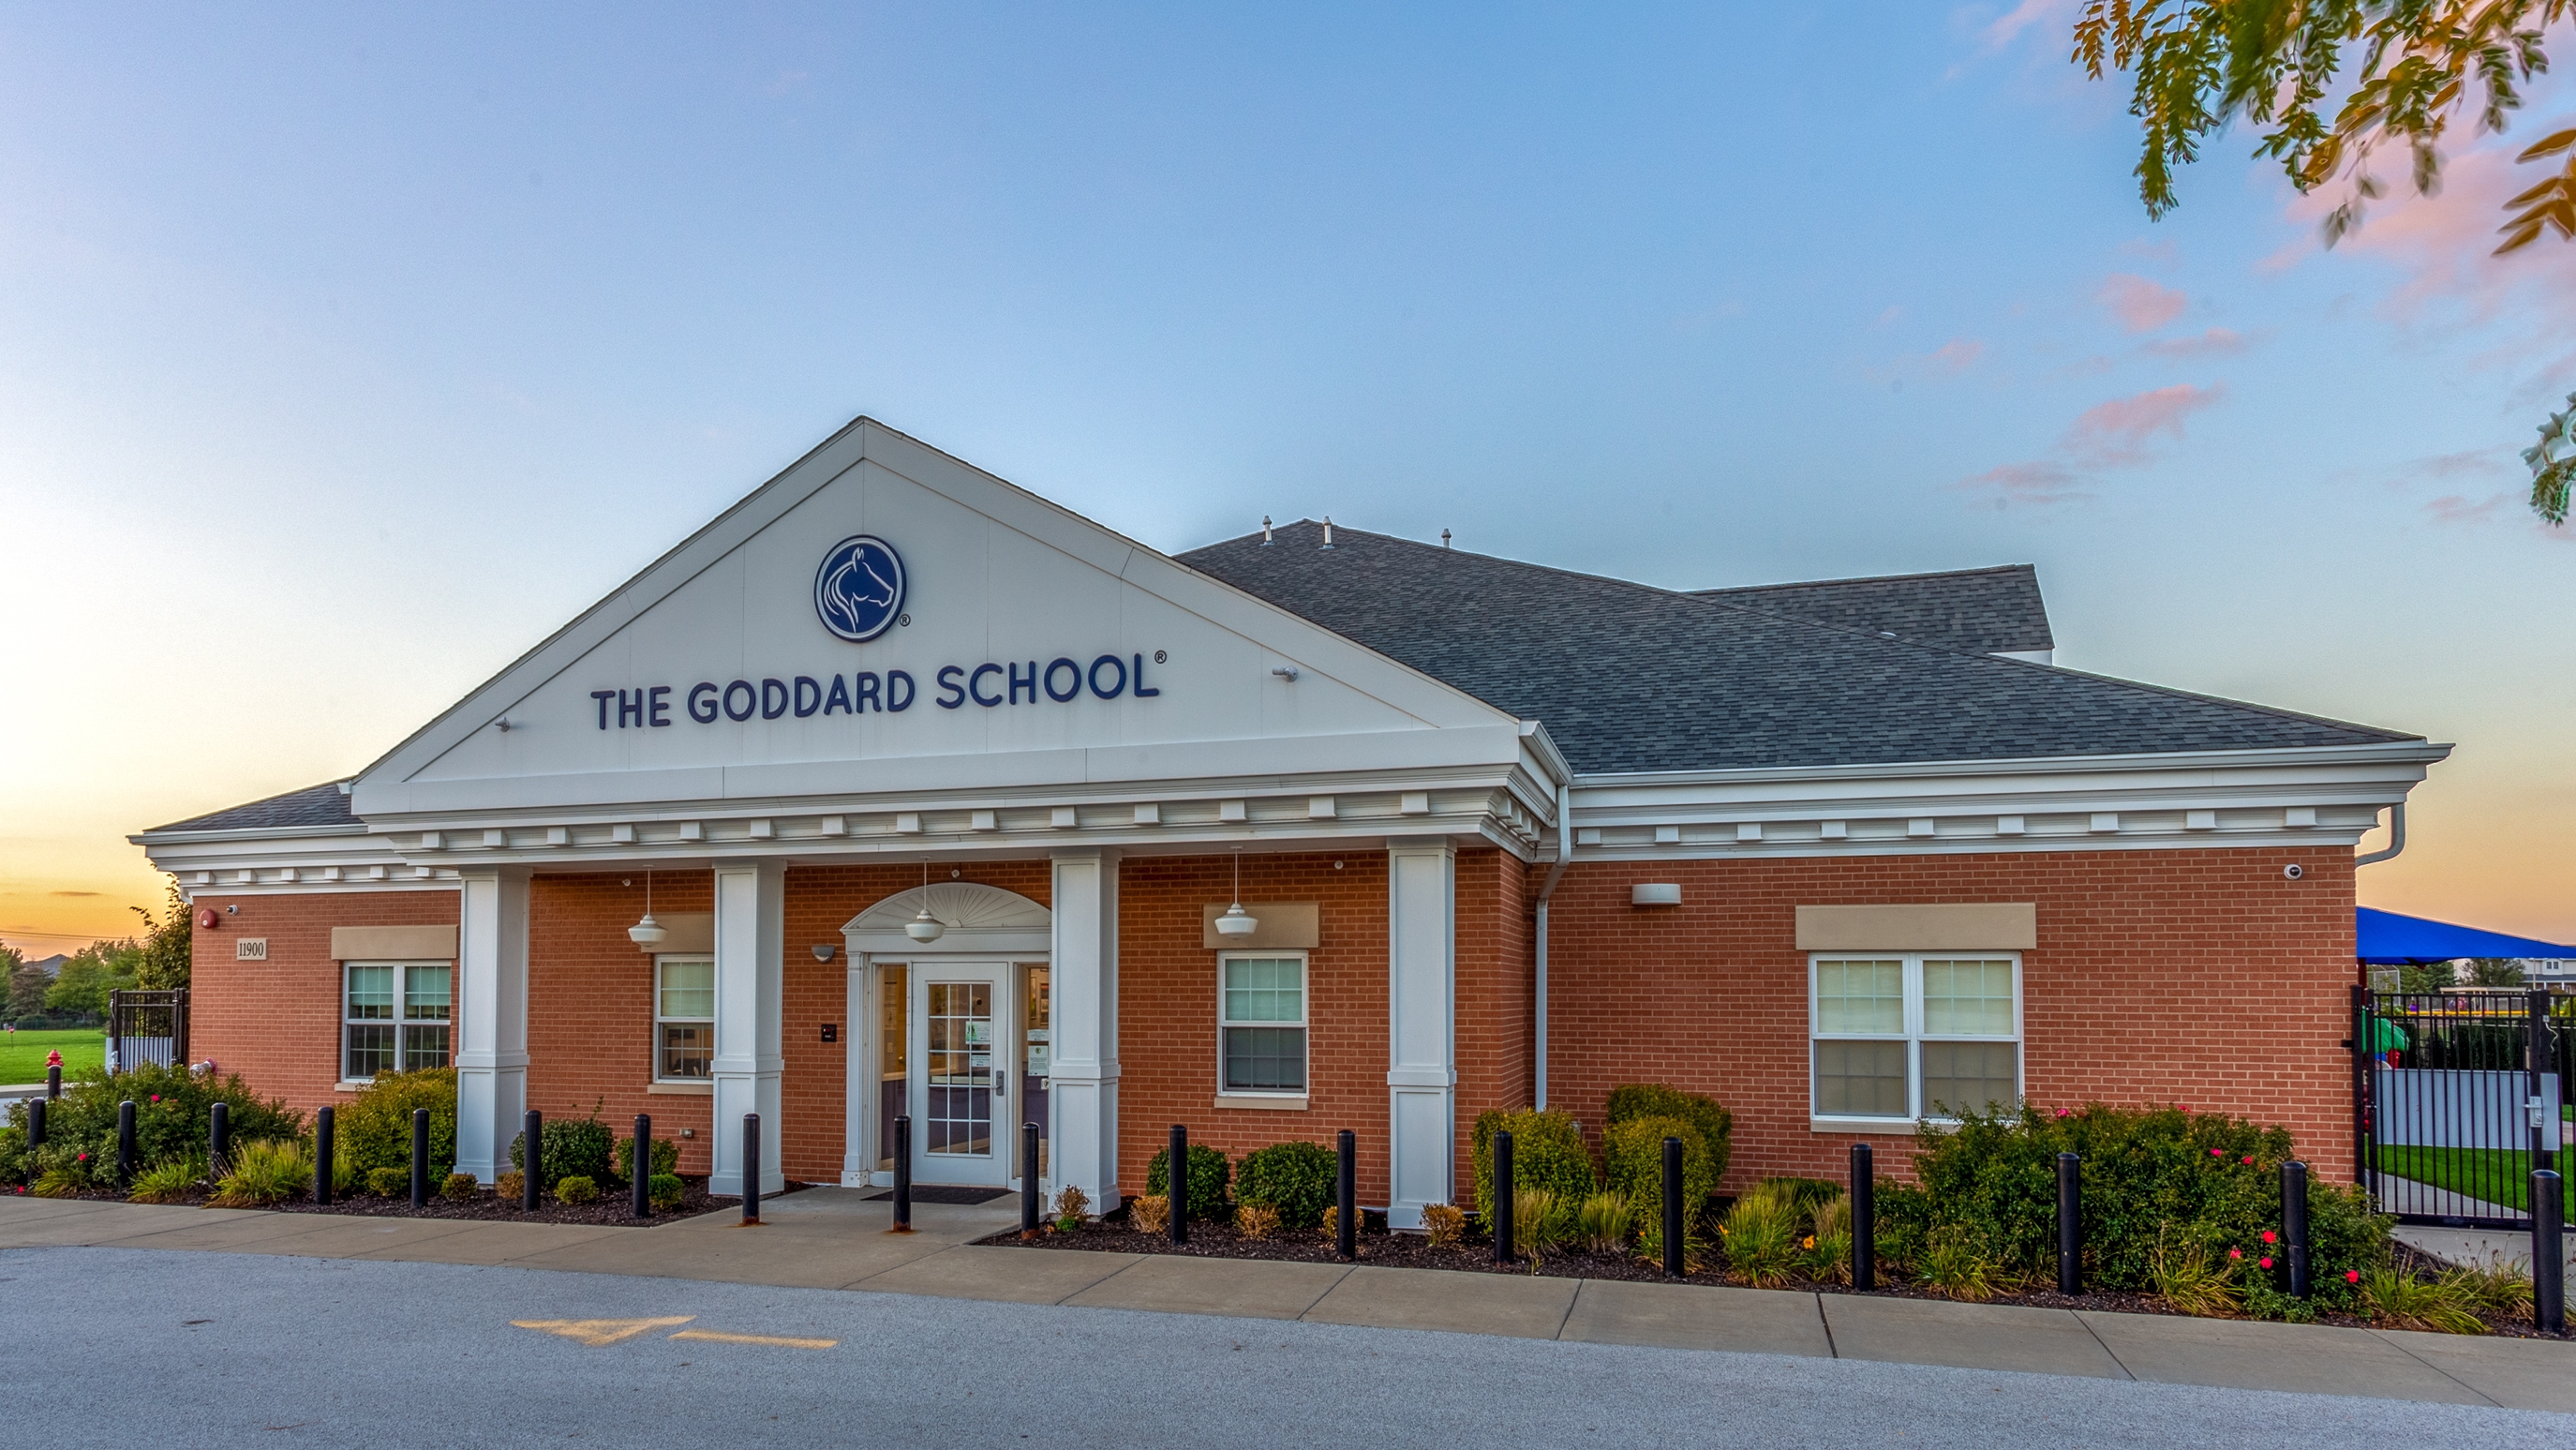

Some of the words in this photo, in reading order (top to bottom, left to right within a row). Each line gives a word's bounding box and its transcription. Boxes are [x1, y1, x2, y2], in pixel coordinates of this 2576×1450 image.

[589, 685, 672, 731] THE
[687, 669, 916, 725] GODDARD
[238, 941, 264, 957] 11900
